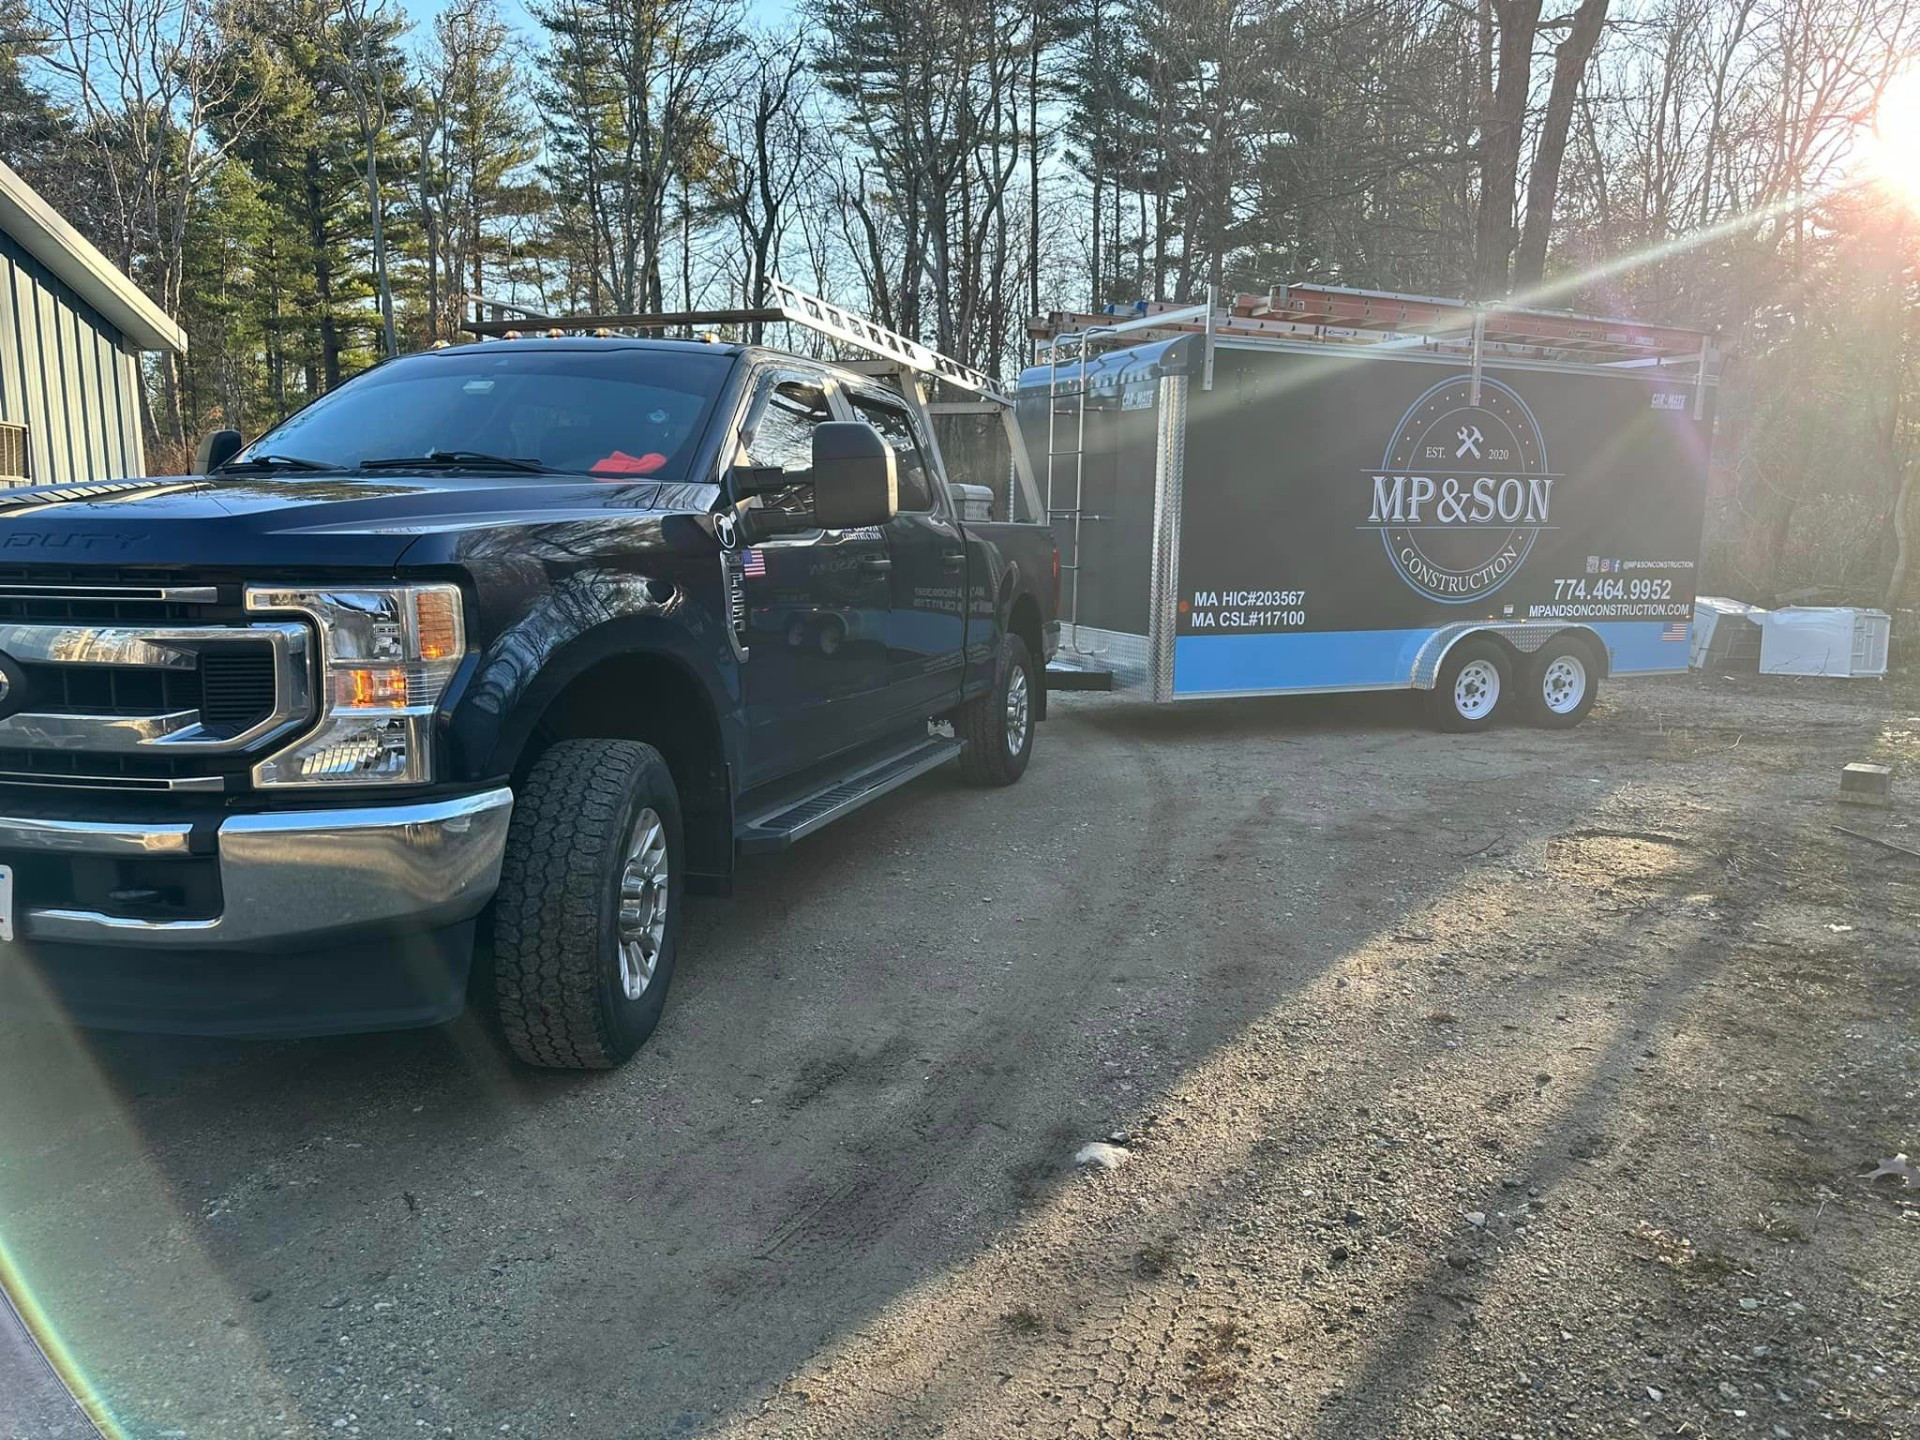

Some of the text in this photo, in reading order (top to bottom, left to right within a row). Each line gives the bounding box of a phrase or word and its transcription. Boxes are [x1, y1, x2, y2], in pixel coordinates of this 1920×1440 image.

[1426, 446, 1509, 461] EST. 2020
[1368, 475, 1554, 523] MP&SON
[3, 532, 150, 550] DUTY
[1401, 545, 1518, 592] CONSTRUCTION
[1554, 578, 1672, 600] 774.464.9952
[1194, 591, 1305, 607] MA HIC#203567
[1529, 603, 1689, 617] MPANDSONCONSTRUCTION.COM
[1191, 611, 1305, 627] MA CSL#117100
